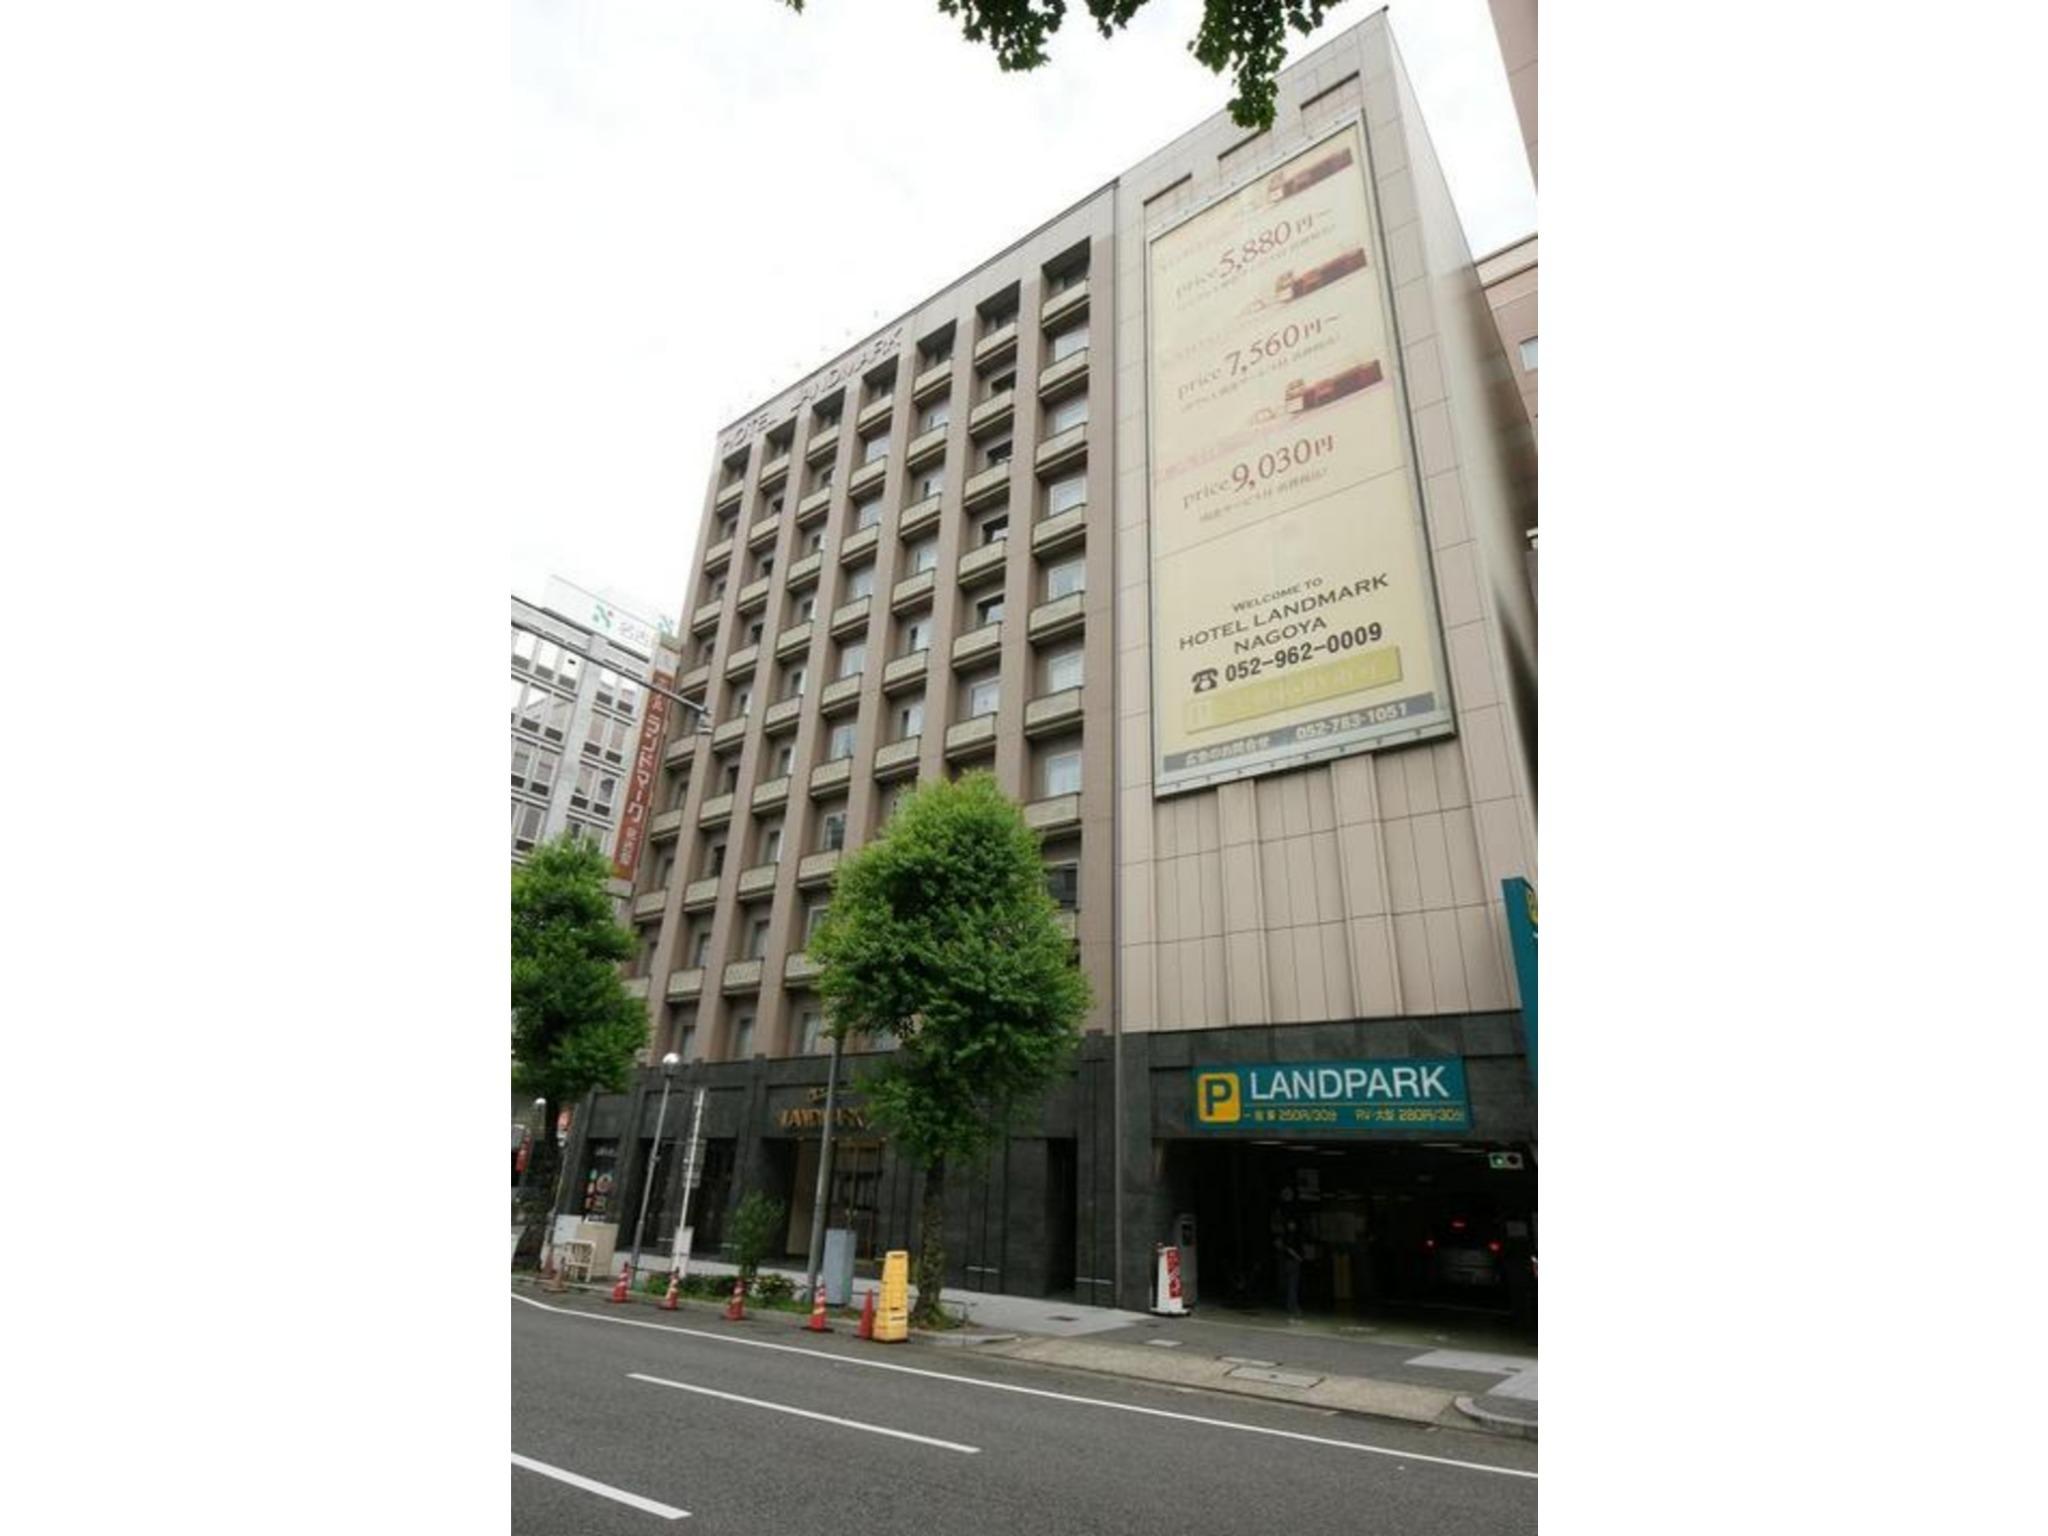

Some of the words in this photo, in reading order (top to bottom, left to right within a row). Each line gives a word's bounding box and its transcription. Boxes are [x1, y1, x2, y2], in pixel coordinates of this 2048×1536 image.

[1177, 366, 1222, 401] price
[1182, 476, 1231, 510] price
[1178, 621, 1249, 651] HOTEL
[1253, 572, 1390, 629] LANDMARK
[1231, 584, 1301, 613] WELCOME
[1304, 576, 1324, 591] TO
[1224, 621, 1383, 683] 052-962-0009
[1233, 616, 1328, 655] NAGOYA
[1203, 1078, 1233, 1117] P
[1249, 1064, 1450, 1100] LANDPARK
